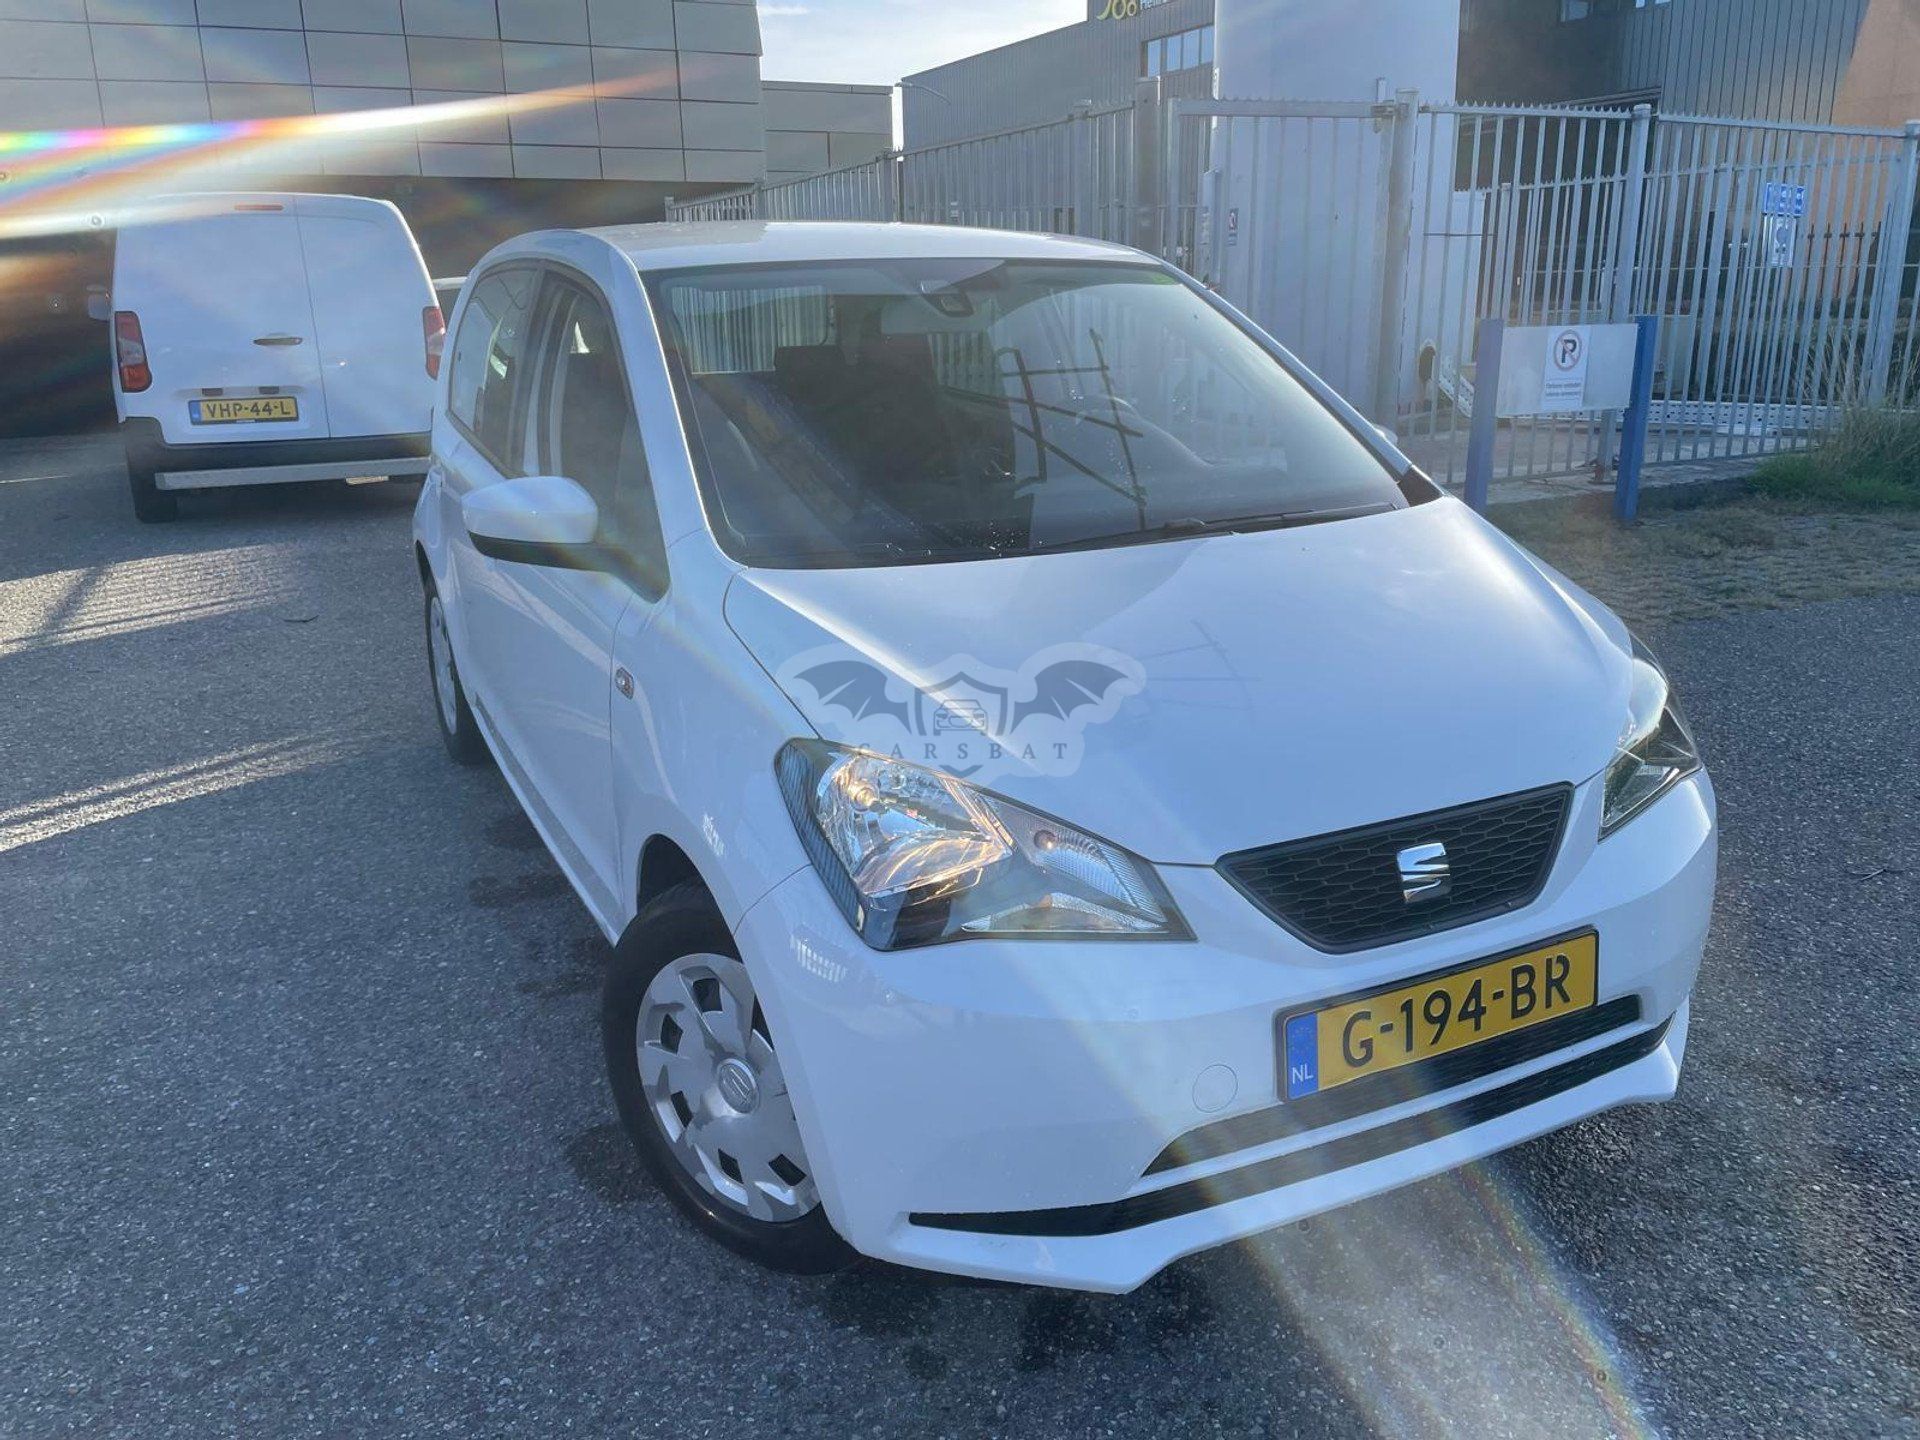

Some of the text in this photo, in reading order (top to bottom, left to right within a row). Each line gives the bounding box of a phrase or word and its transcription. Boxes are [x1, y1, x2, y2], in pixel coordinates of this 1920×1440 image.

[1561, 339, 1577, 363] P
[206, 401, 291, 418] VHP-44-L
[1342, 953, 1571, 1068] G-194-BR
[1292, 1063, 1314, 1085] NL
